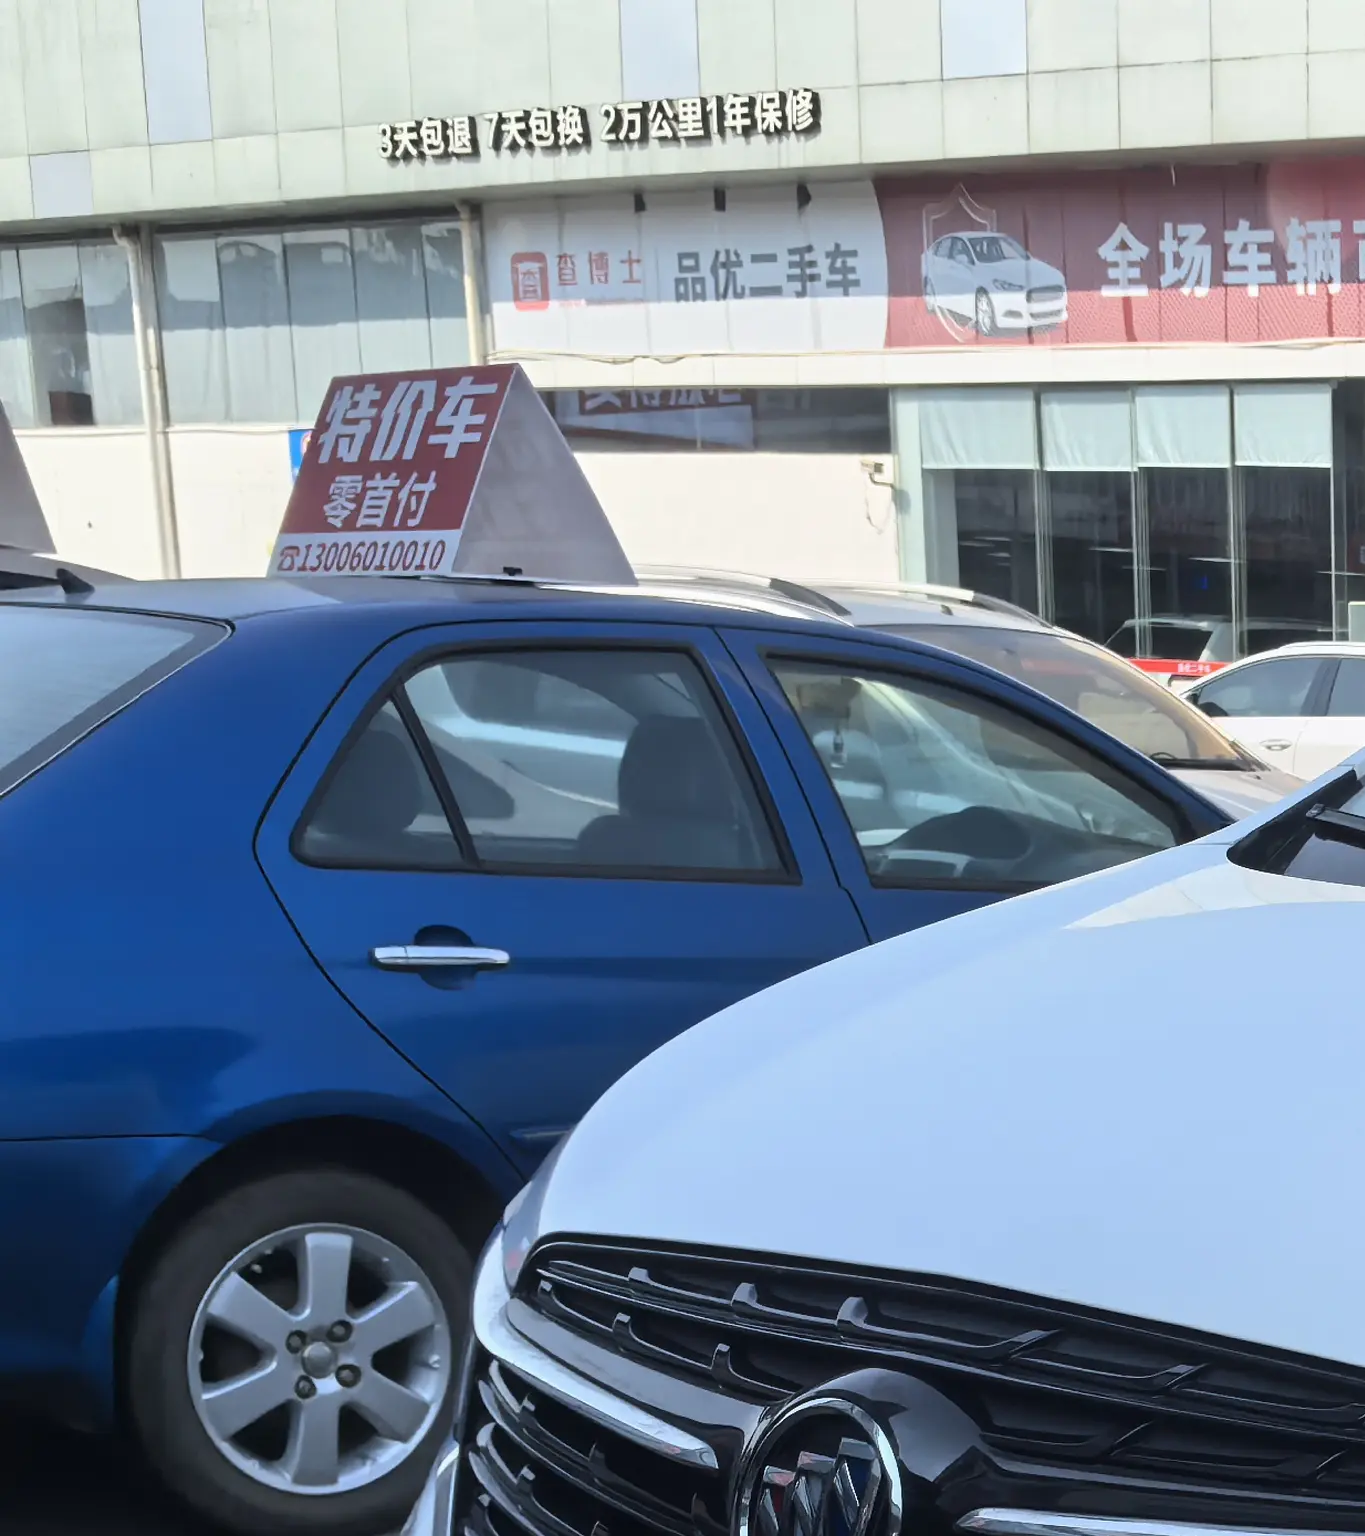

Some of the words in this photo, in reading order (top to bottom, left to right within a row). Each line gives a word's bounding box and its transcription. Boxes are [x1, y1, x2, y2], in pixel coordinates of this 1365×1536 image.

[378, 115, 478, 160] 3天包退
[483, 103, 590, 151] 7天包换
[599, 88, 820, 144] 2万公里1年保修
[556, 250, 644, 287] 查博士
[673, 242, 861, 304] 品优二手车
[317, 376, 498, 463] 特价车
[322, 470, 437, 528] 零首付
[297, 539, 446, 573] 13006010010
